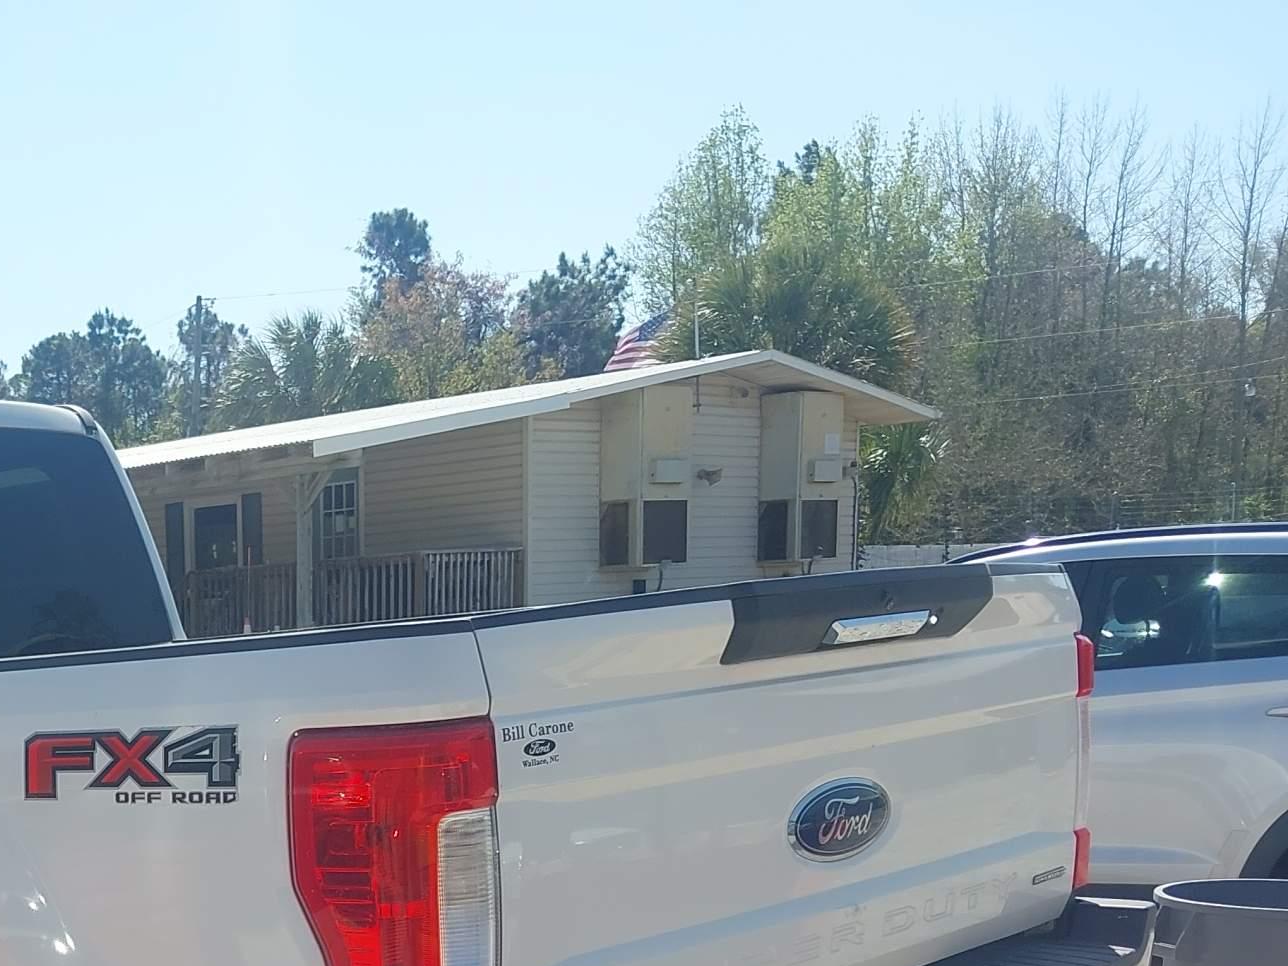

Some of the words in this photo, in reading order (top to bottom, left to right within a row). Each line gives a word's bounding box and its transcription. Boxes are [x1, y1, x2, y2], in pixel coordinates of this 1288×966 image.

[502, 725, 525, 742] Bill
[528, 721, 574, 737] Carone
[24, 726, 240, 800] FX4
[115, 791, 162, 804] OFF
[171, 791, 237, 804] ROAD
[818, 796, 873, 845] Ford
[880, 872, 1018, 938] DUTY
